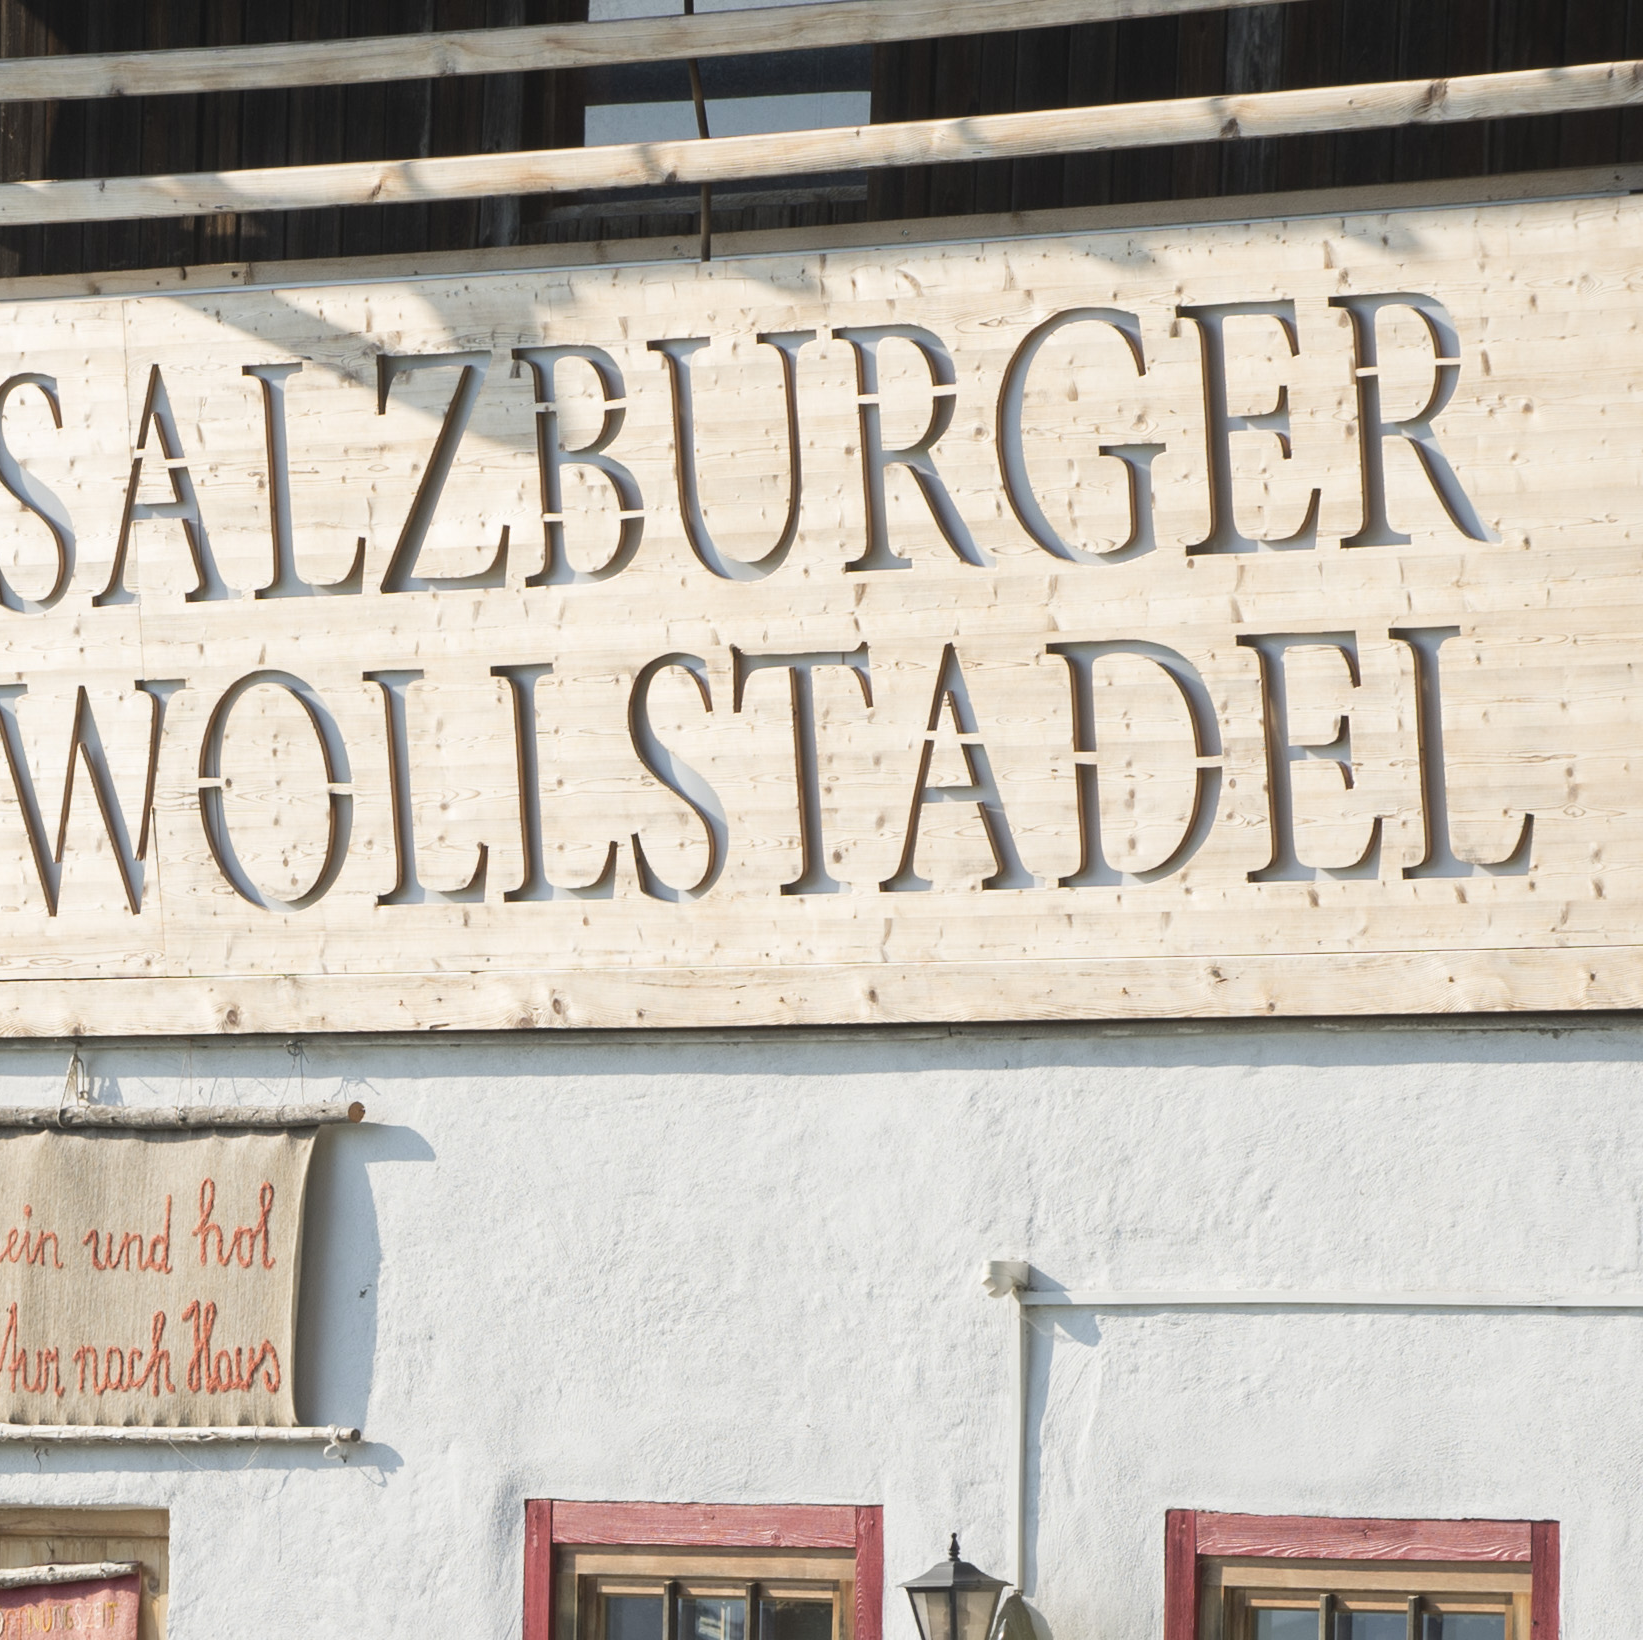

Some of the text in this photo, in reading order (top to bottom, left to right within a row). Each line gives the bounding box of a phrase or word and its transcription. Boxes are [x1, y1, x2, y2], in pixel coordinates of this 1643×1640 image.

[83, 1195, 172, 1274] und
[192, 1177, 276, 1269] hol
[73, 1310, 175, 1397] nach
[182, 1300, 281, 1394] Haus
